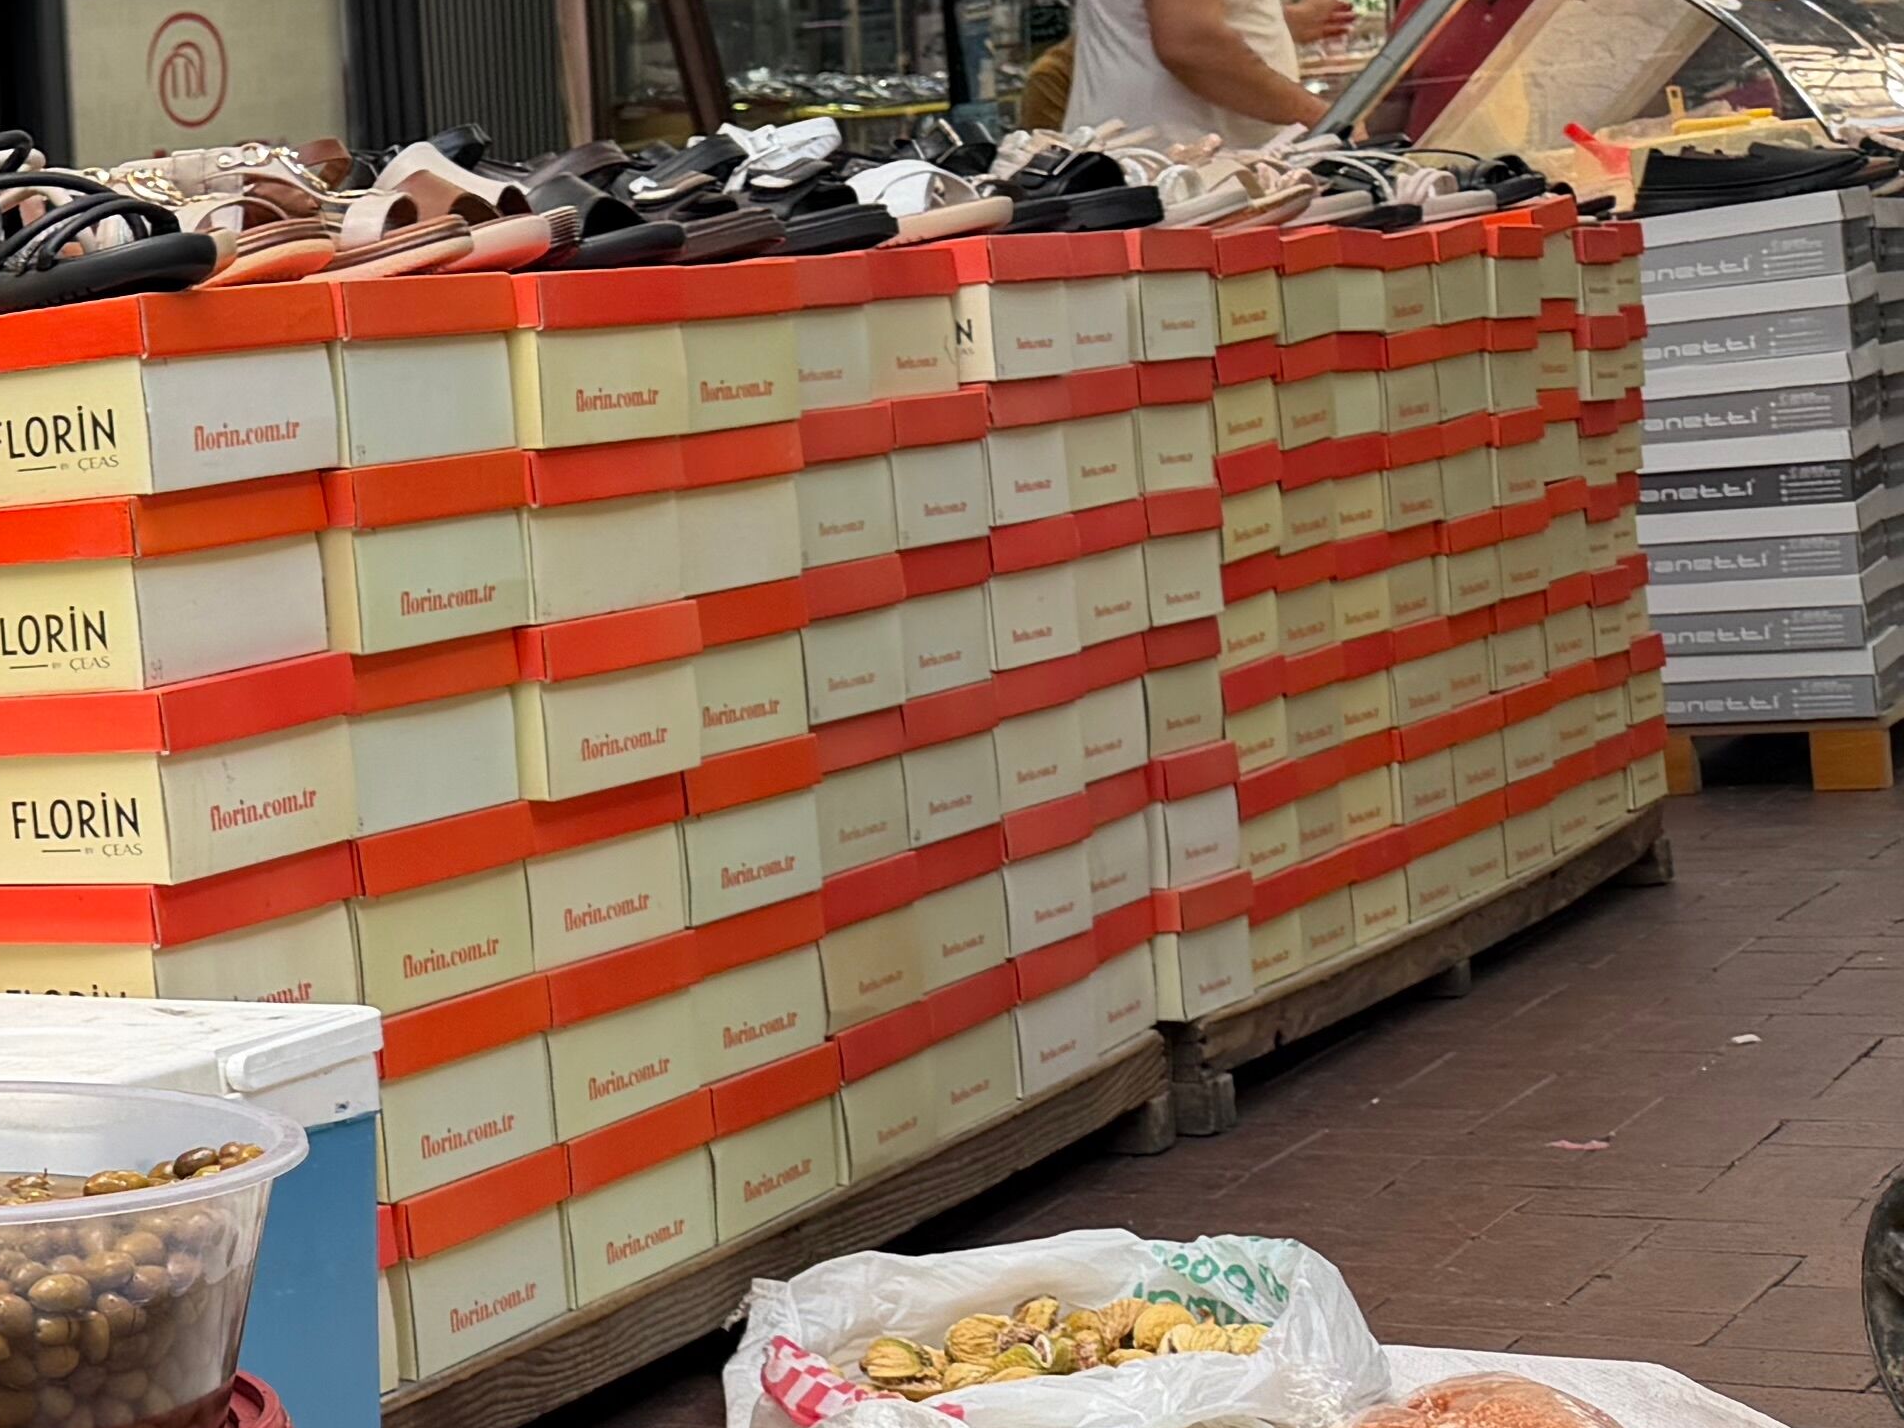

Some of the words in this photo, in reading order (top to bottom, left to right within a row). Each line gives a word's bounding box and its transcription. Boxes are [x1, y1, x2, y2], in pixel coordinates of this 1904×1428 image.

[1640, 258, 1749, 283] anetti
[1643, 336, 1755, 361] anetti
[576, 387, 659, 414] florin.com.tr
[700, 379, 774, 403] florin.com.tr
[193, 419, 300, 452] florin.com.tr
[1644, 409, 1756, 432] anetti
[1640, 482, 1752, 502] anetti
[1654, 553, 1768, 573] anetti
[400, 583, 496, 617] florin.com.tr
[1662, 625, 1770, 645] anetti
[702, 698, 780, 729] florin.com.tr
[1667, 695, 1779, 714] anetti
[580, 725, 668, 762] florin.com.tr
[12, 791, 141, 840] FLORİN
[210, 787, 317, 833] florin.com.tr
[720, 854, 796, 890] florin.com.tr
[564, 893, 650, 932] florin.com.tr
[402, 936, 500, 979] florin.com.tr
[723, 1010, 798, 1049] florin.com.tr
[588, 1057, 671, 1101] florin.com.tr
[420, 1112, 515, 1160] florin.com.tr
[743, 1159, 812, 1203] florin.com.tr
[605, 1218, 685, 1265] florin.com.tr
[449, 1281, 538, 1334] florin.com.tr
